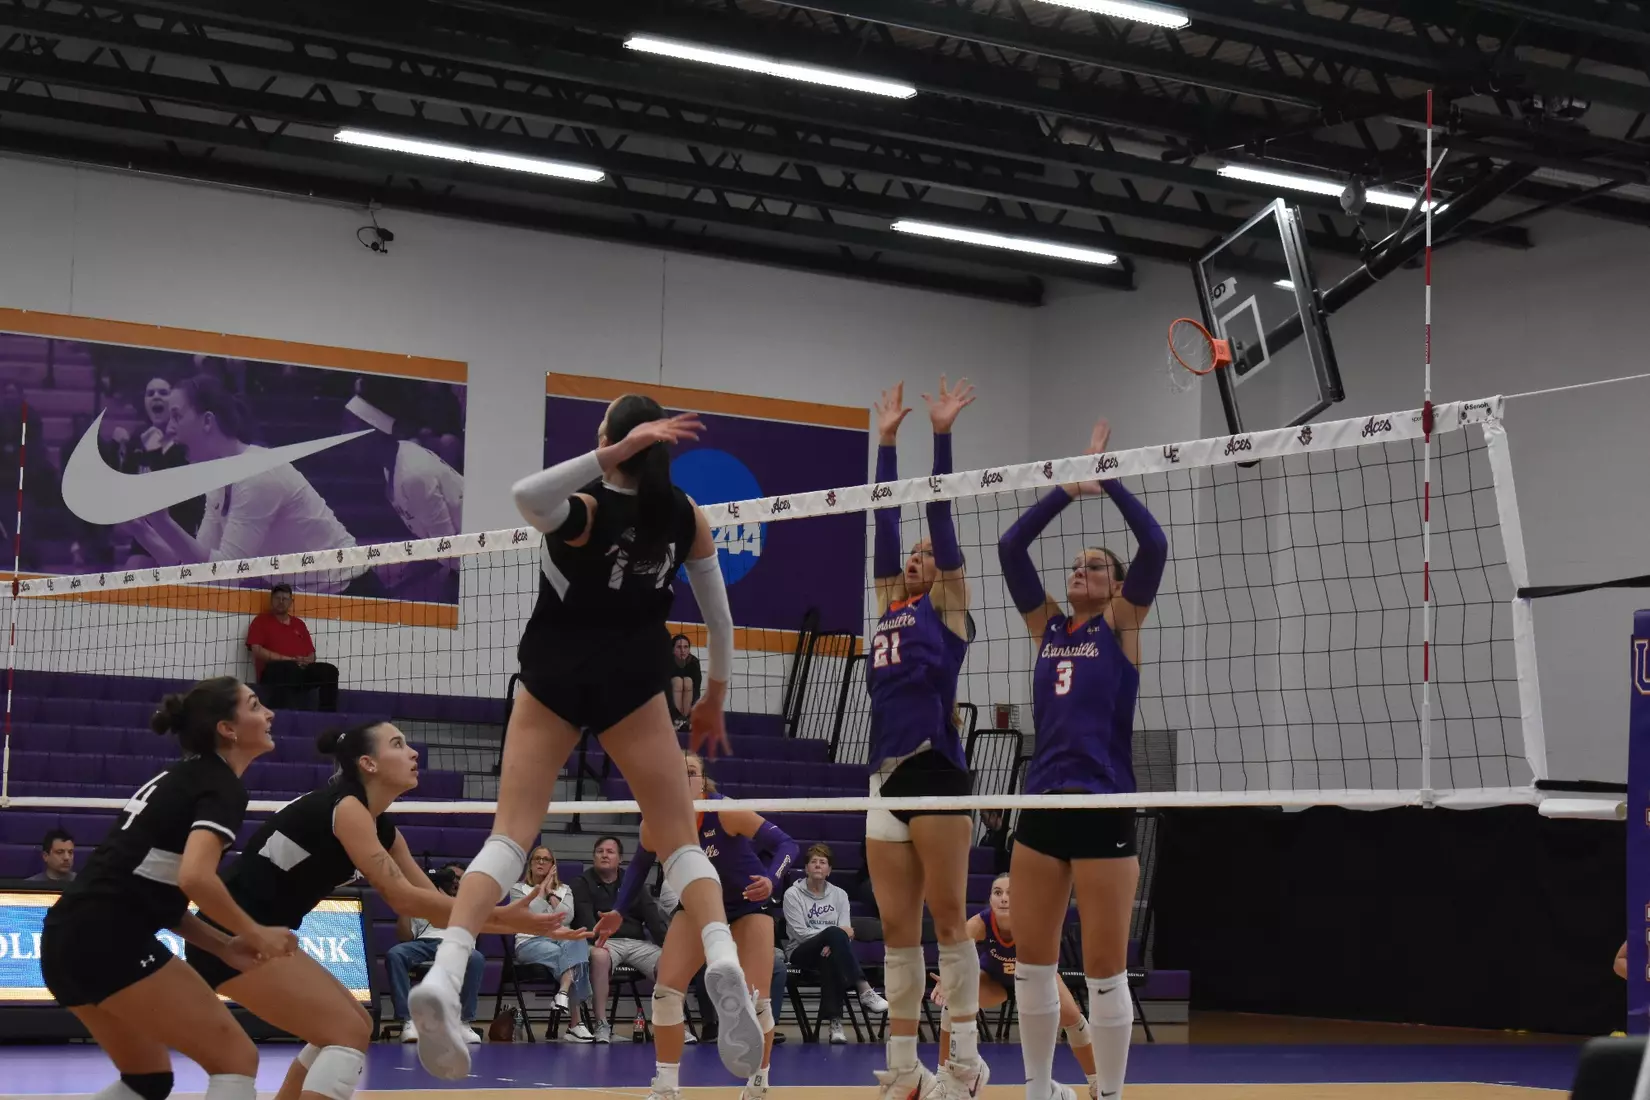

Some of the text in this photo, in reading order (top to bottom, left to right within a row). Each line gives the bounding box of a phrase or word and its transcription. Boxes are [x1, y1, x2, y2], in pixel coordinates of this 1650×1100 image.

[728, 416, 1392, 518] UE Aces Aces UE Aces Aces UE Aces Aces
[301, 553, 315, 566] Aces
[366, 546, 381, 560] Aces
[437, 538, 452, 552] Aces
[512, 529, 528, 544] Aces
[873, 631, 902, 669] 21
[1055, 660, 1073, 696] 3
[121, 771, 169, 830] 4
[807, 902, 835, 918] Aces
